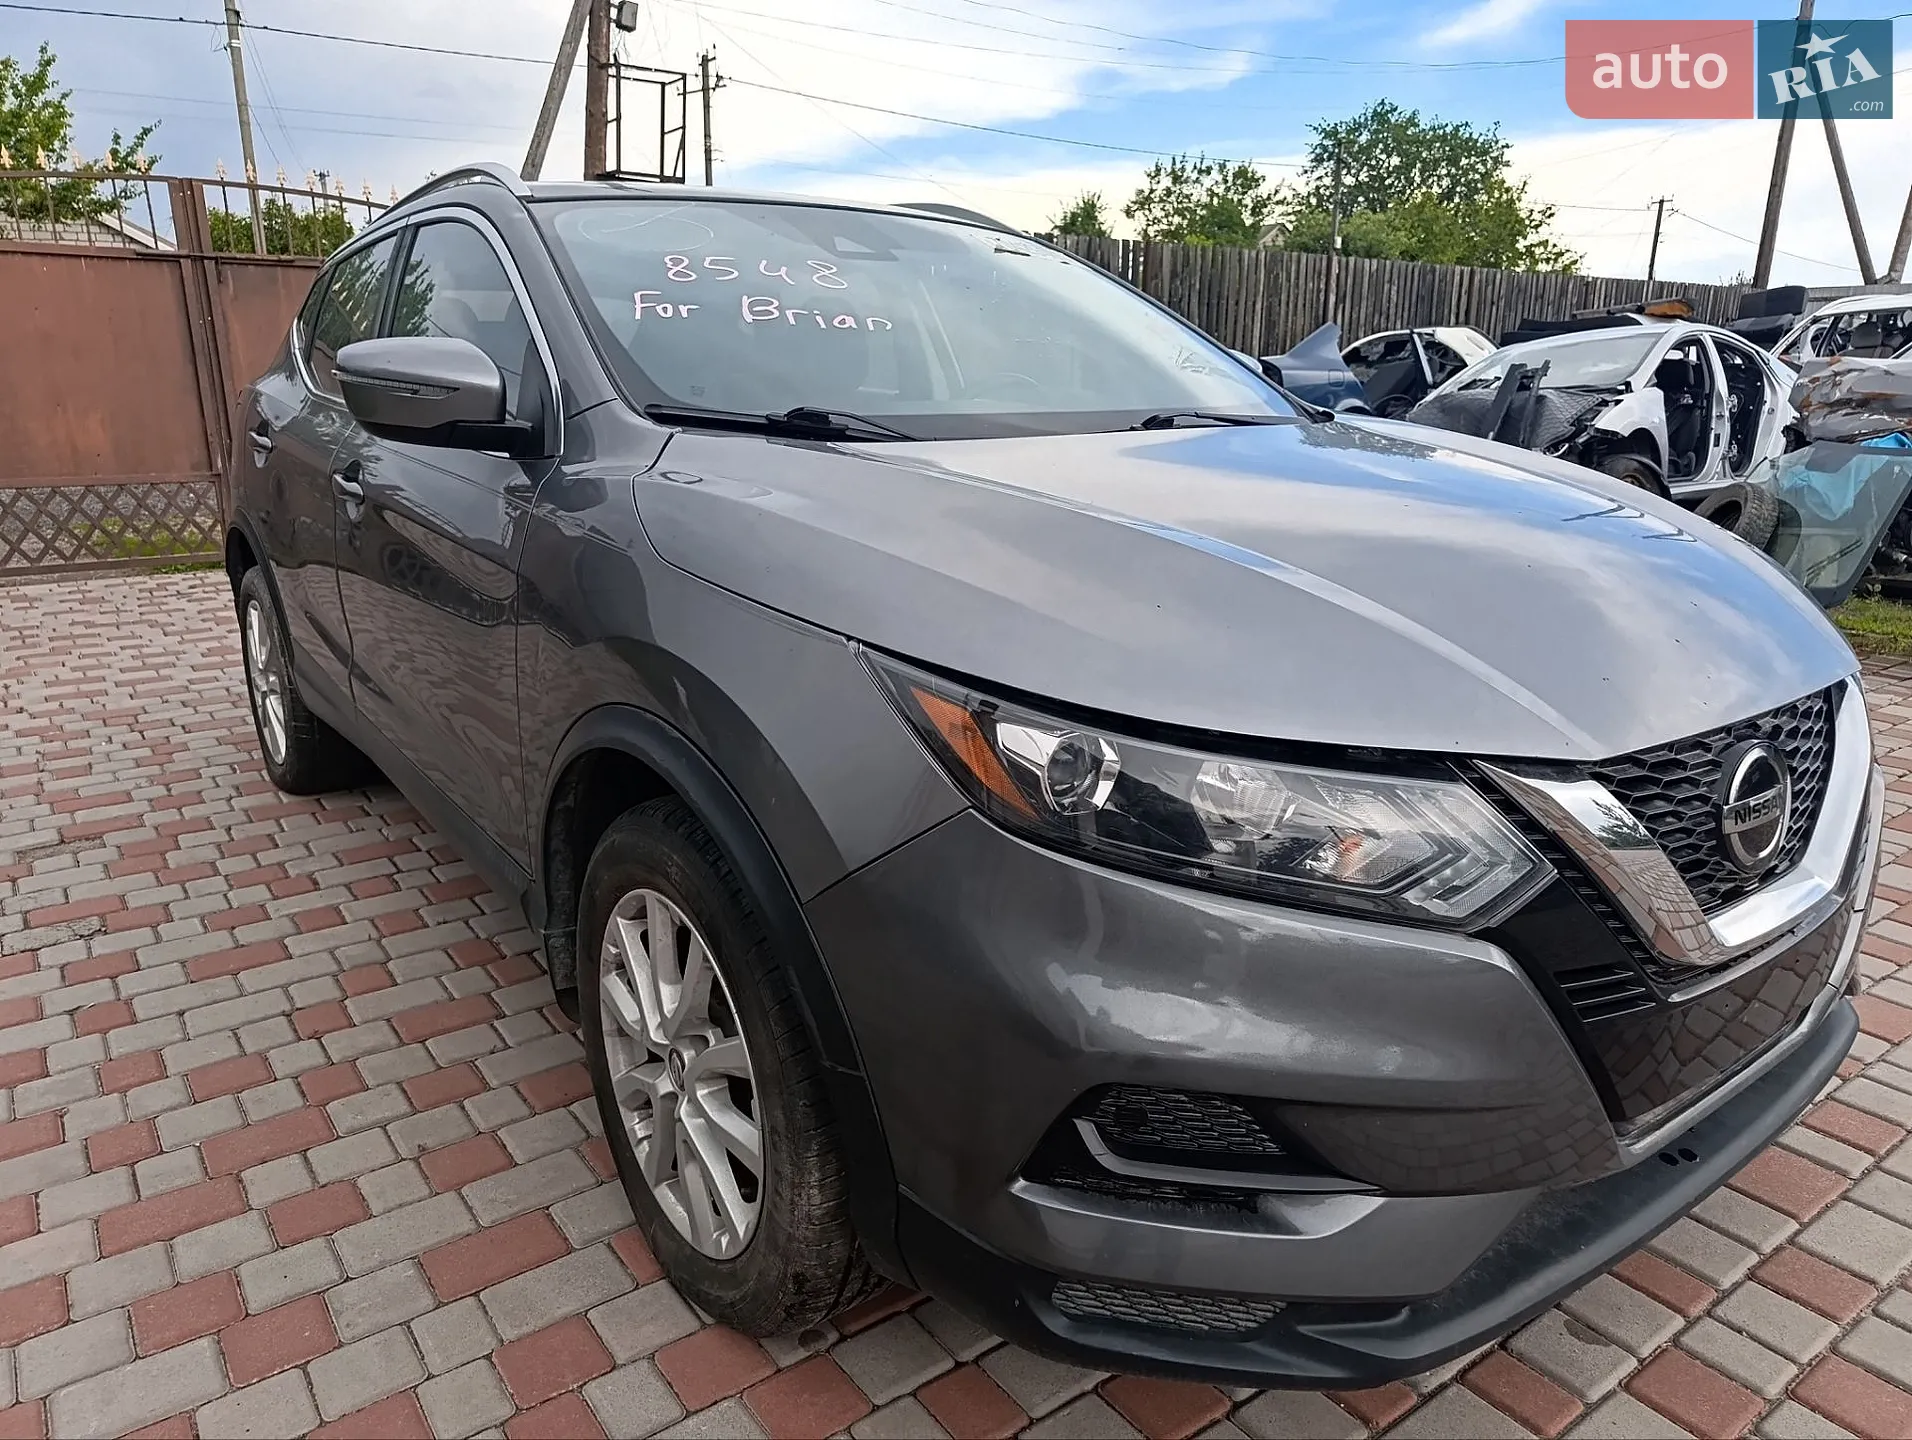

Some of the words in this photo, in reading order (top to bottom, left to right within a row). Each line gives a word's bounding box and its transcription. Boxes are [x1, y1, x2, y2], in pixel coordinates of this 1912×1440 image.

[664, 254, 849, 290] 8548
[633, 290, 701, 320] For
[741, 294, 894, 332] Brian
